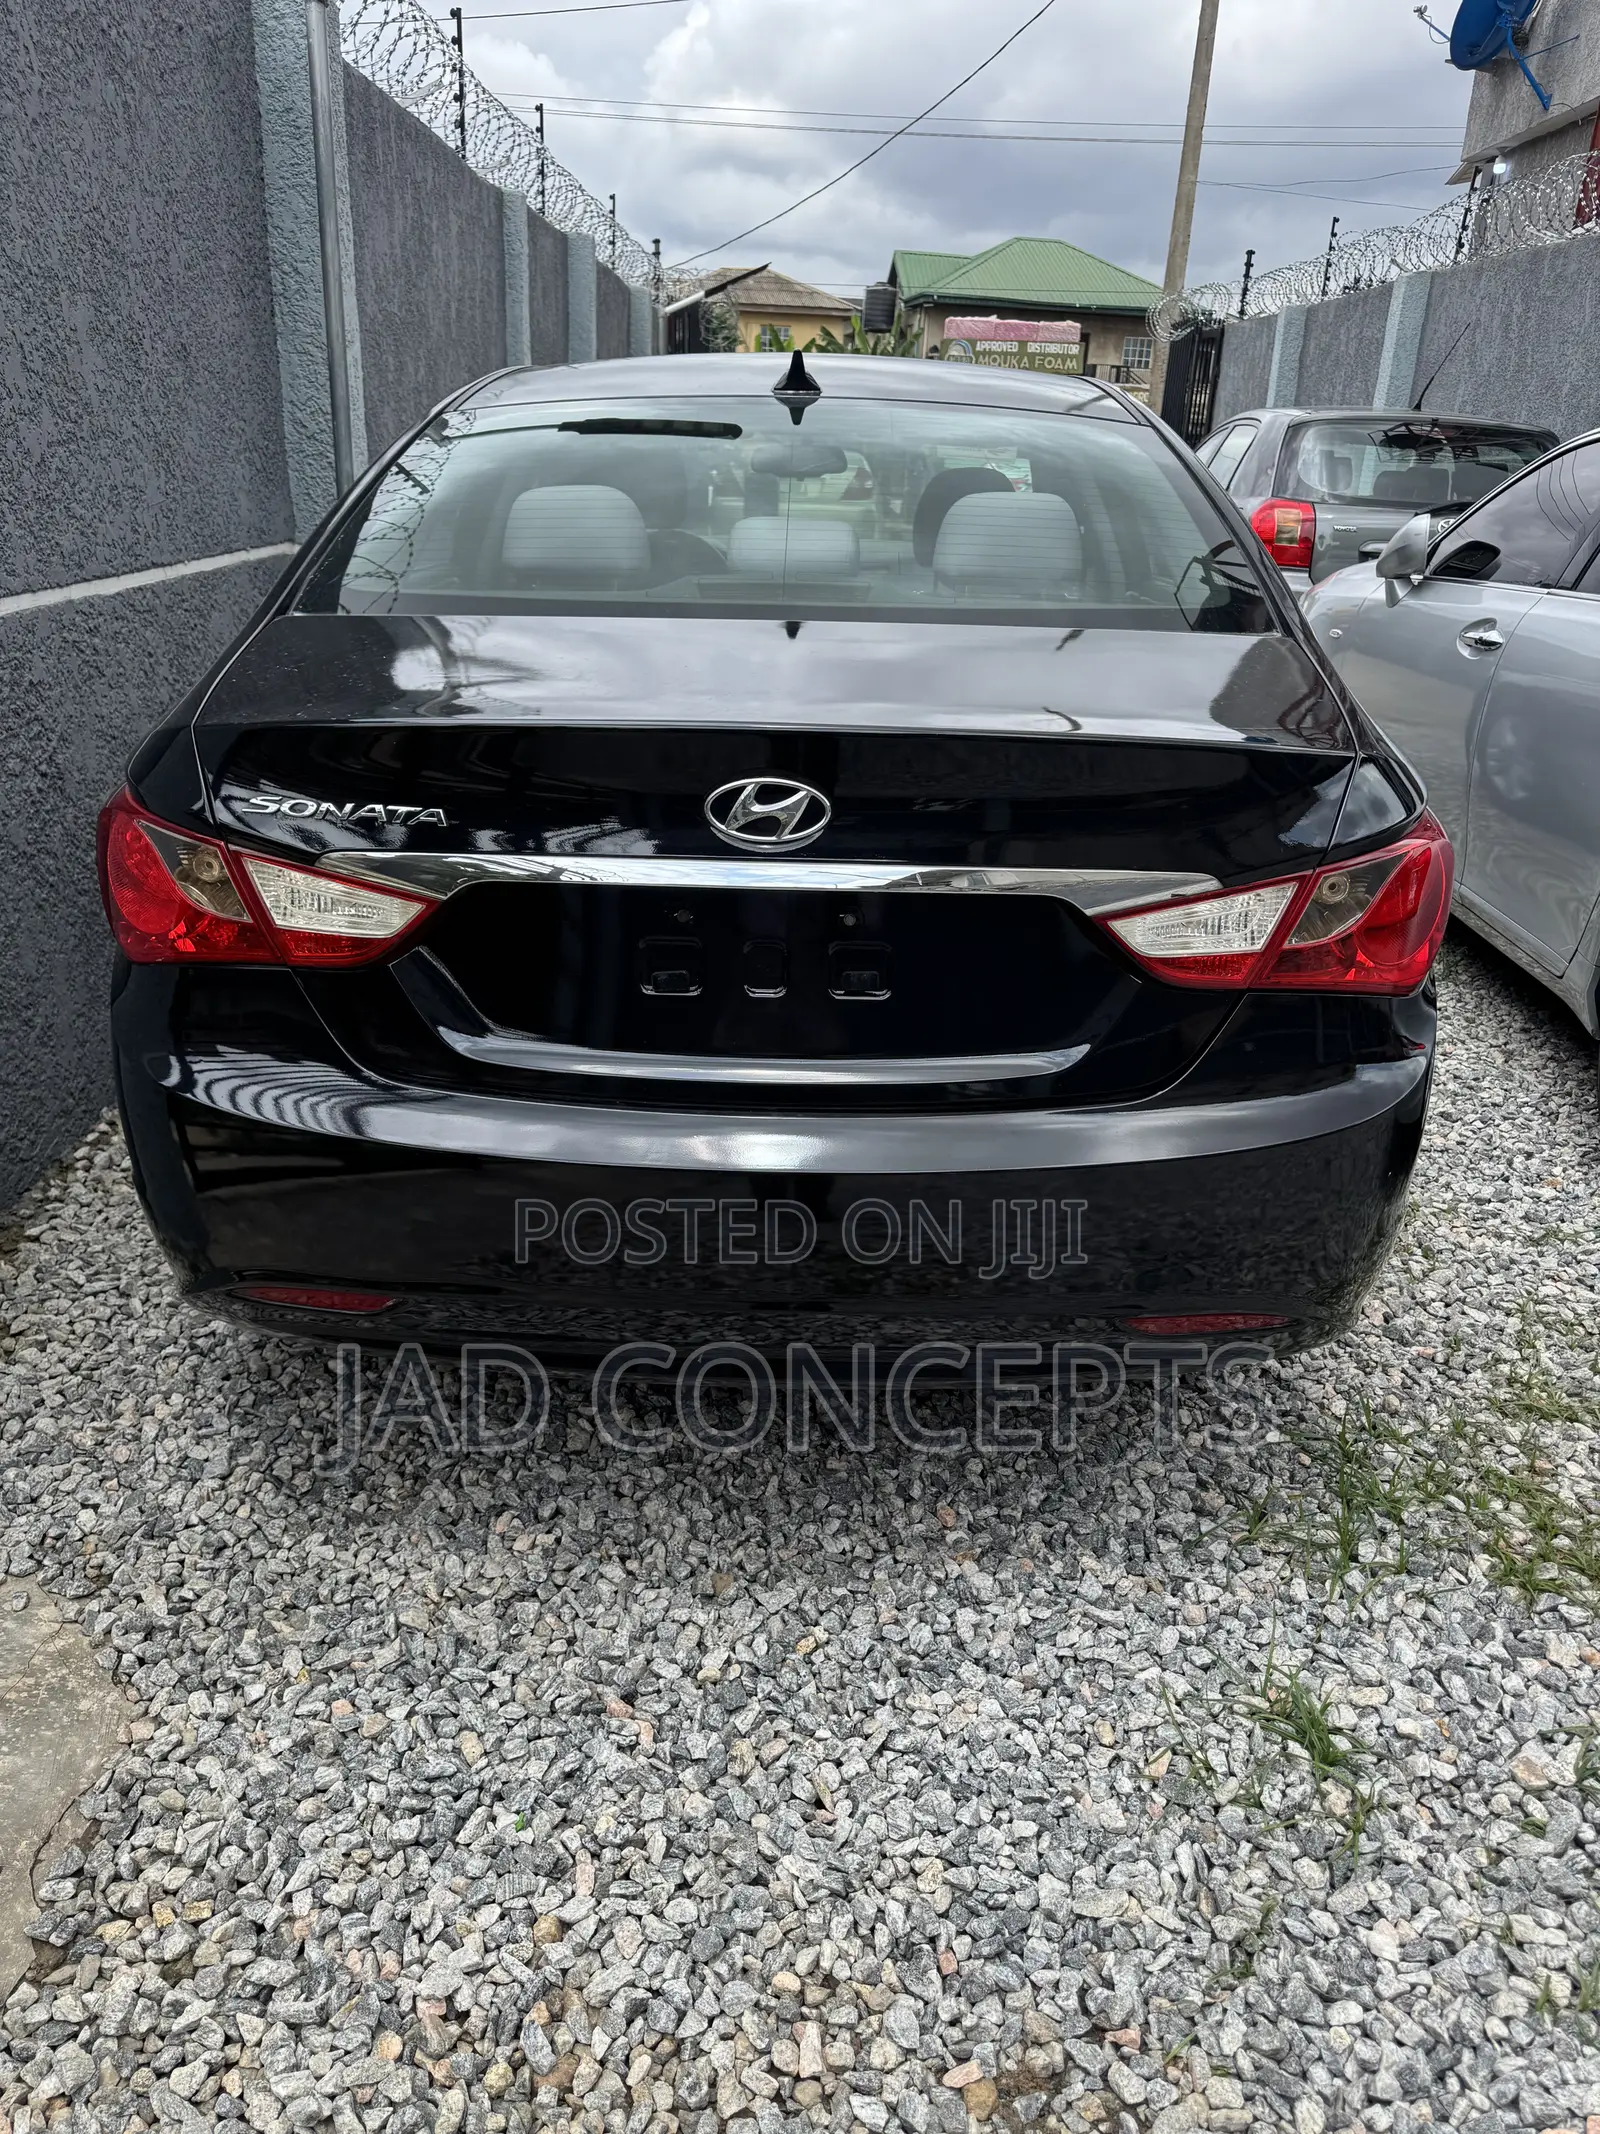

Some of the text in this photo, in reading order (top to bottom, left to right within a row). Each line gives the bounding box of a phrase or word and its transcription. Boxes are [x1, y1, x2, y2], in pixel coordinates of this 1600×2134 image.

[976, 340, 1080, 354] APPROVED DISTRIBUTOR
[978, 354, 1030, 369] MOUKA
[1034, 356, 1077, 370] FOAM
[241, 796, 447, 827] SONATA
